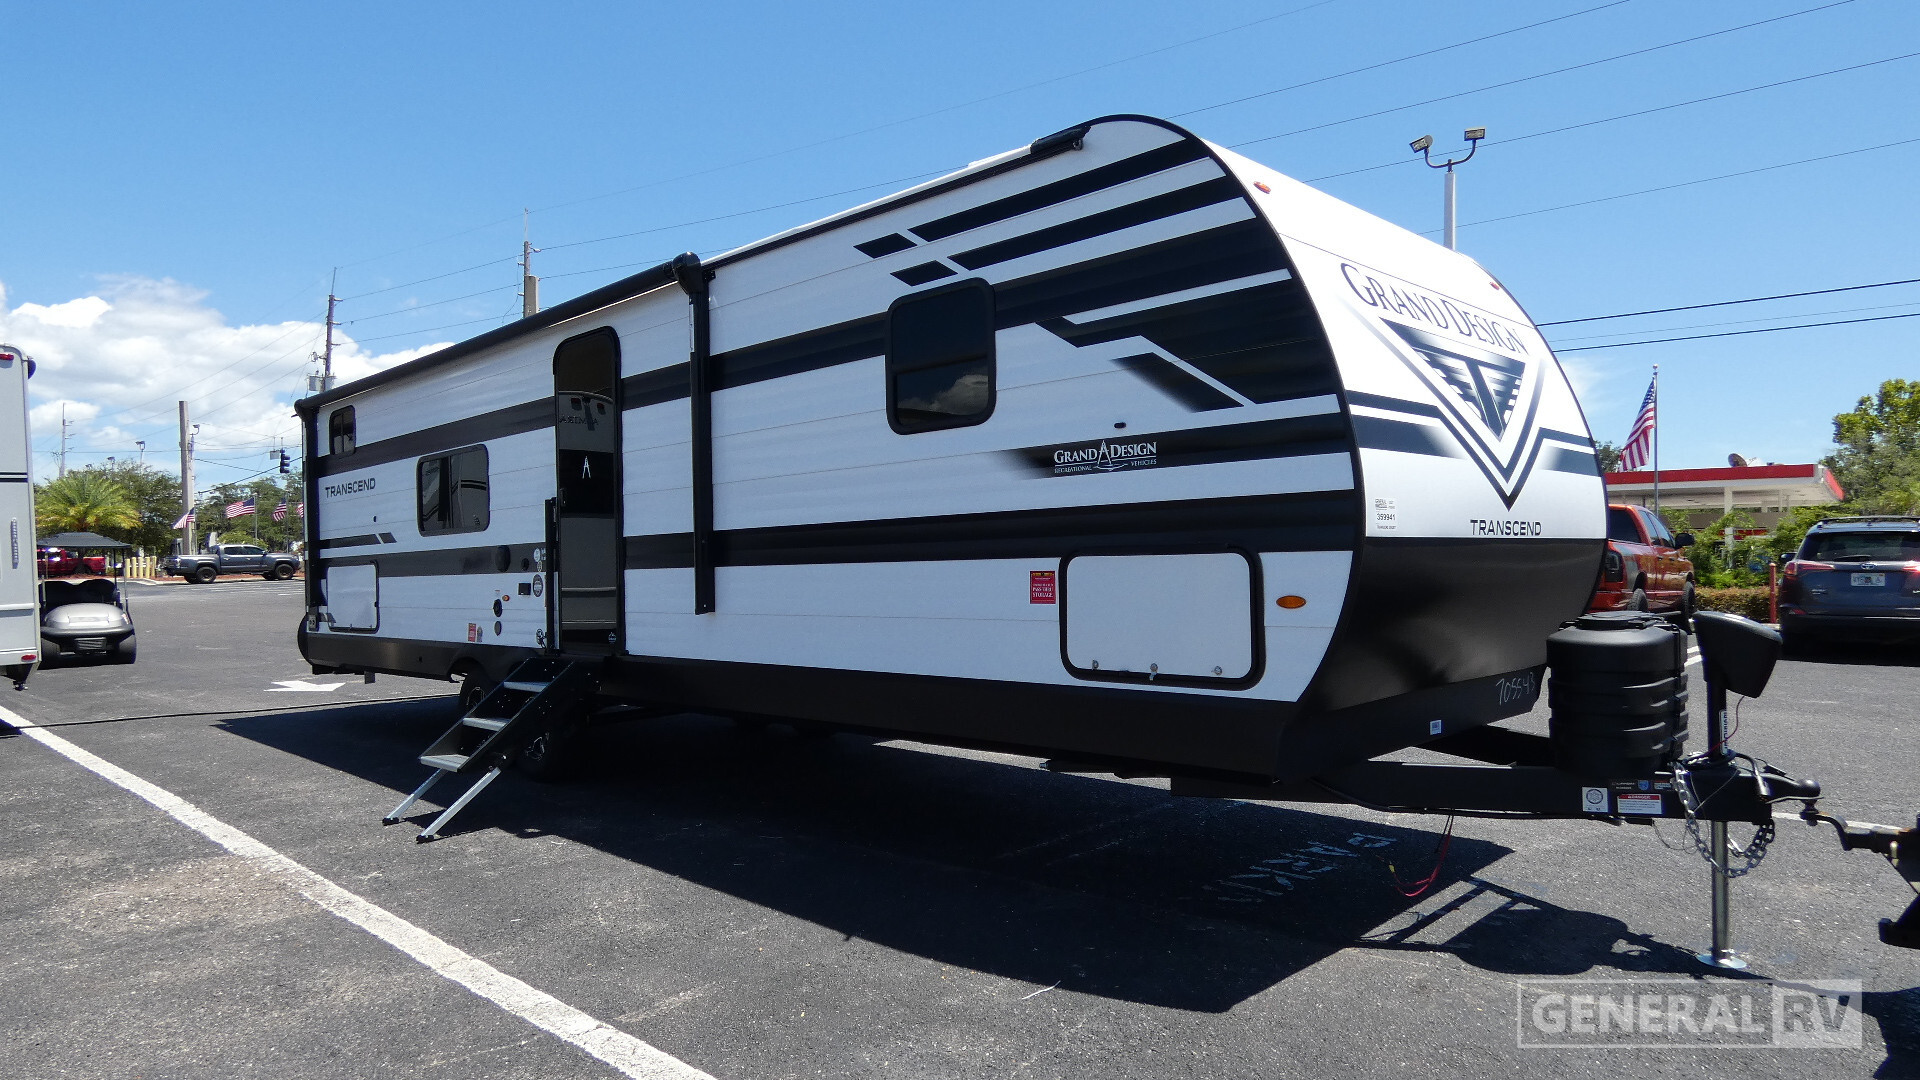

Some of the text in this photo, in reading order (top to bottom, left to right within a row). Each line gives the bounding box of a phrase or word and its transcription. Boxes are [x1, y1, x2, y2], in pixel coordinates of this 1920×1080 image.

[1340, 262, 1530, 355] GRAND DESIGN
[1053, 441, 1157, 464] GRAND DESIGN
[324, 477, 376, 499] TRANSCEND
[1470, 519, 1542, 537] TRANSCEND
